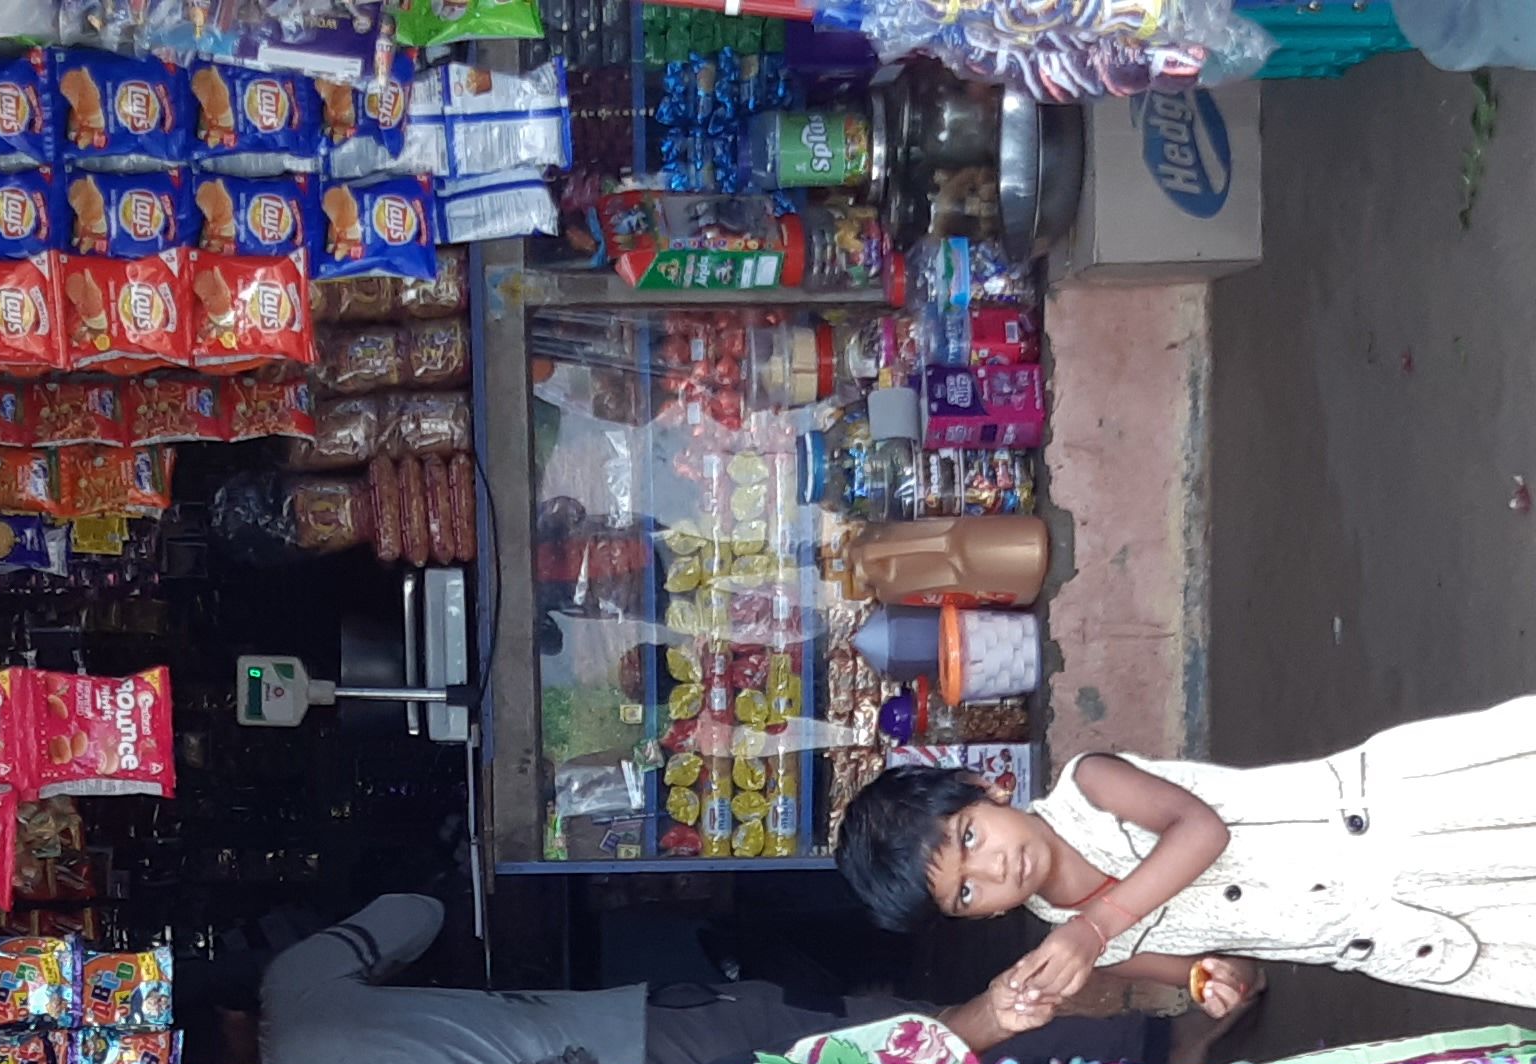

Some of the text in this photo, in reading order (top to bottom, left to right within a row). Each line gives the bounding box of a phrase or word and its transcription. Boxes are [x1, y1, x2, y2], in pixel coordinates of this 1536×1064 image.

[0, 84, 23, 131] Lay's
[127, 84, 151, 129] Lay's
[255, 84, 279, 126] Lay's
[2, 191, 26, 236] Lay's
[132, 192, 157, 237] Lay's
[258, 197, 282, 240] Lay's
[385, 198, 406, 240] Lay's
[2, 289, 28, 335] Lay's
[131, 285, 155, 329] Lay's
[259, 284, 284, 328] Lay's
